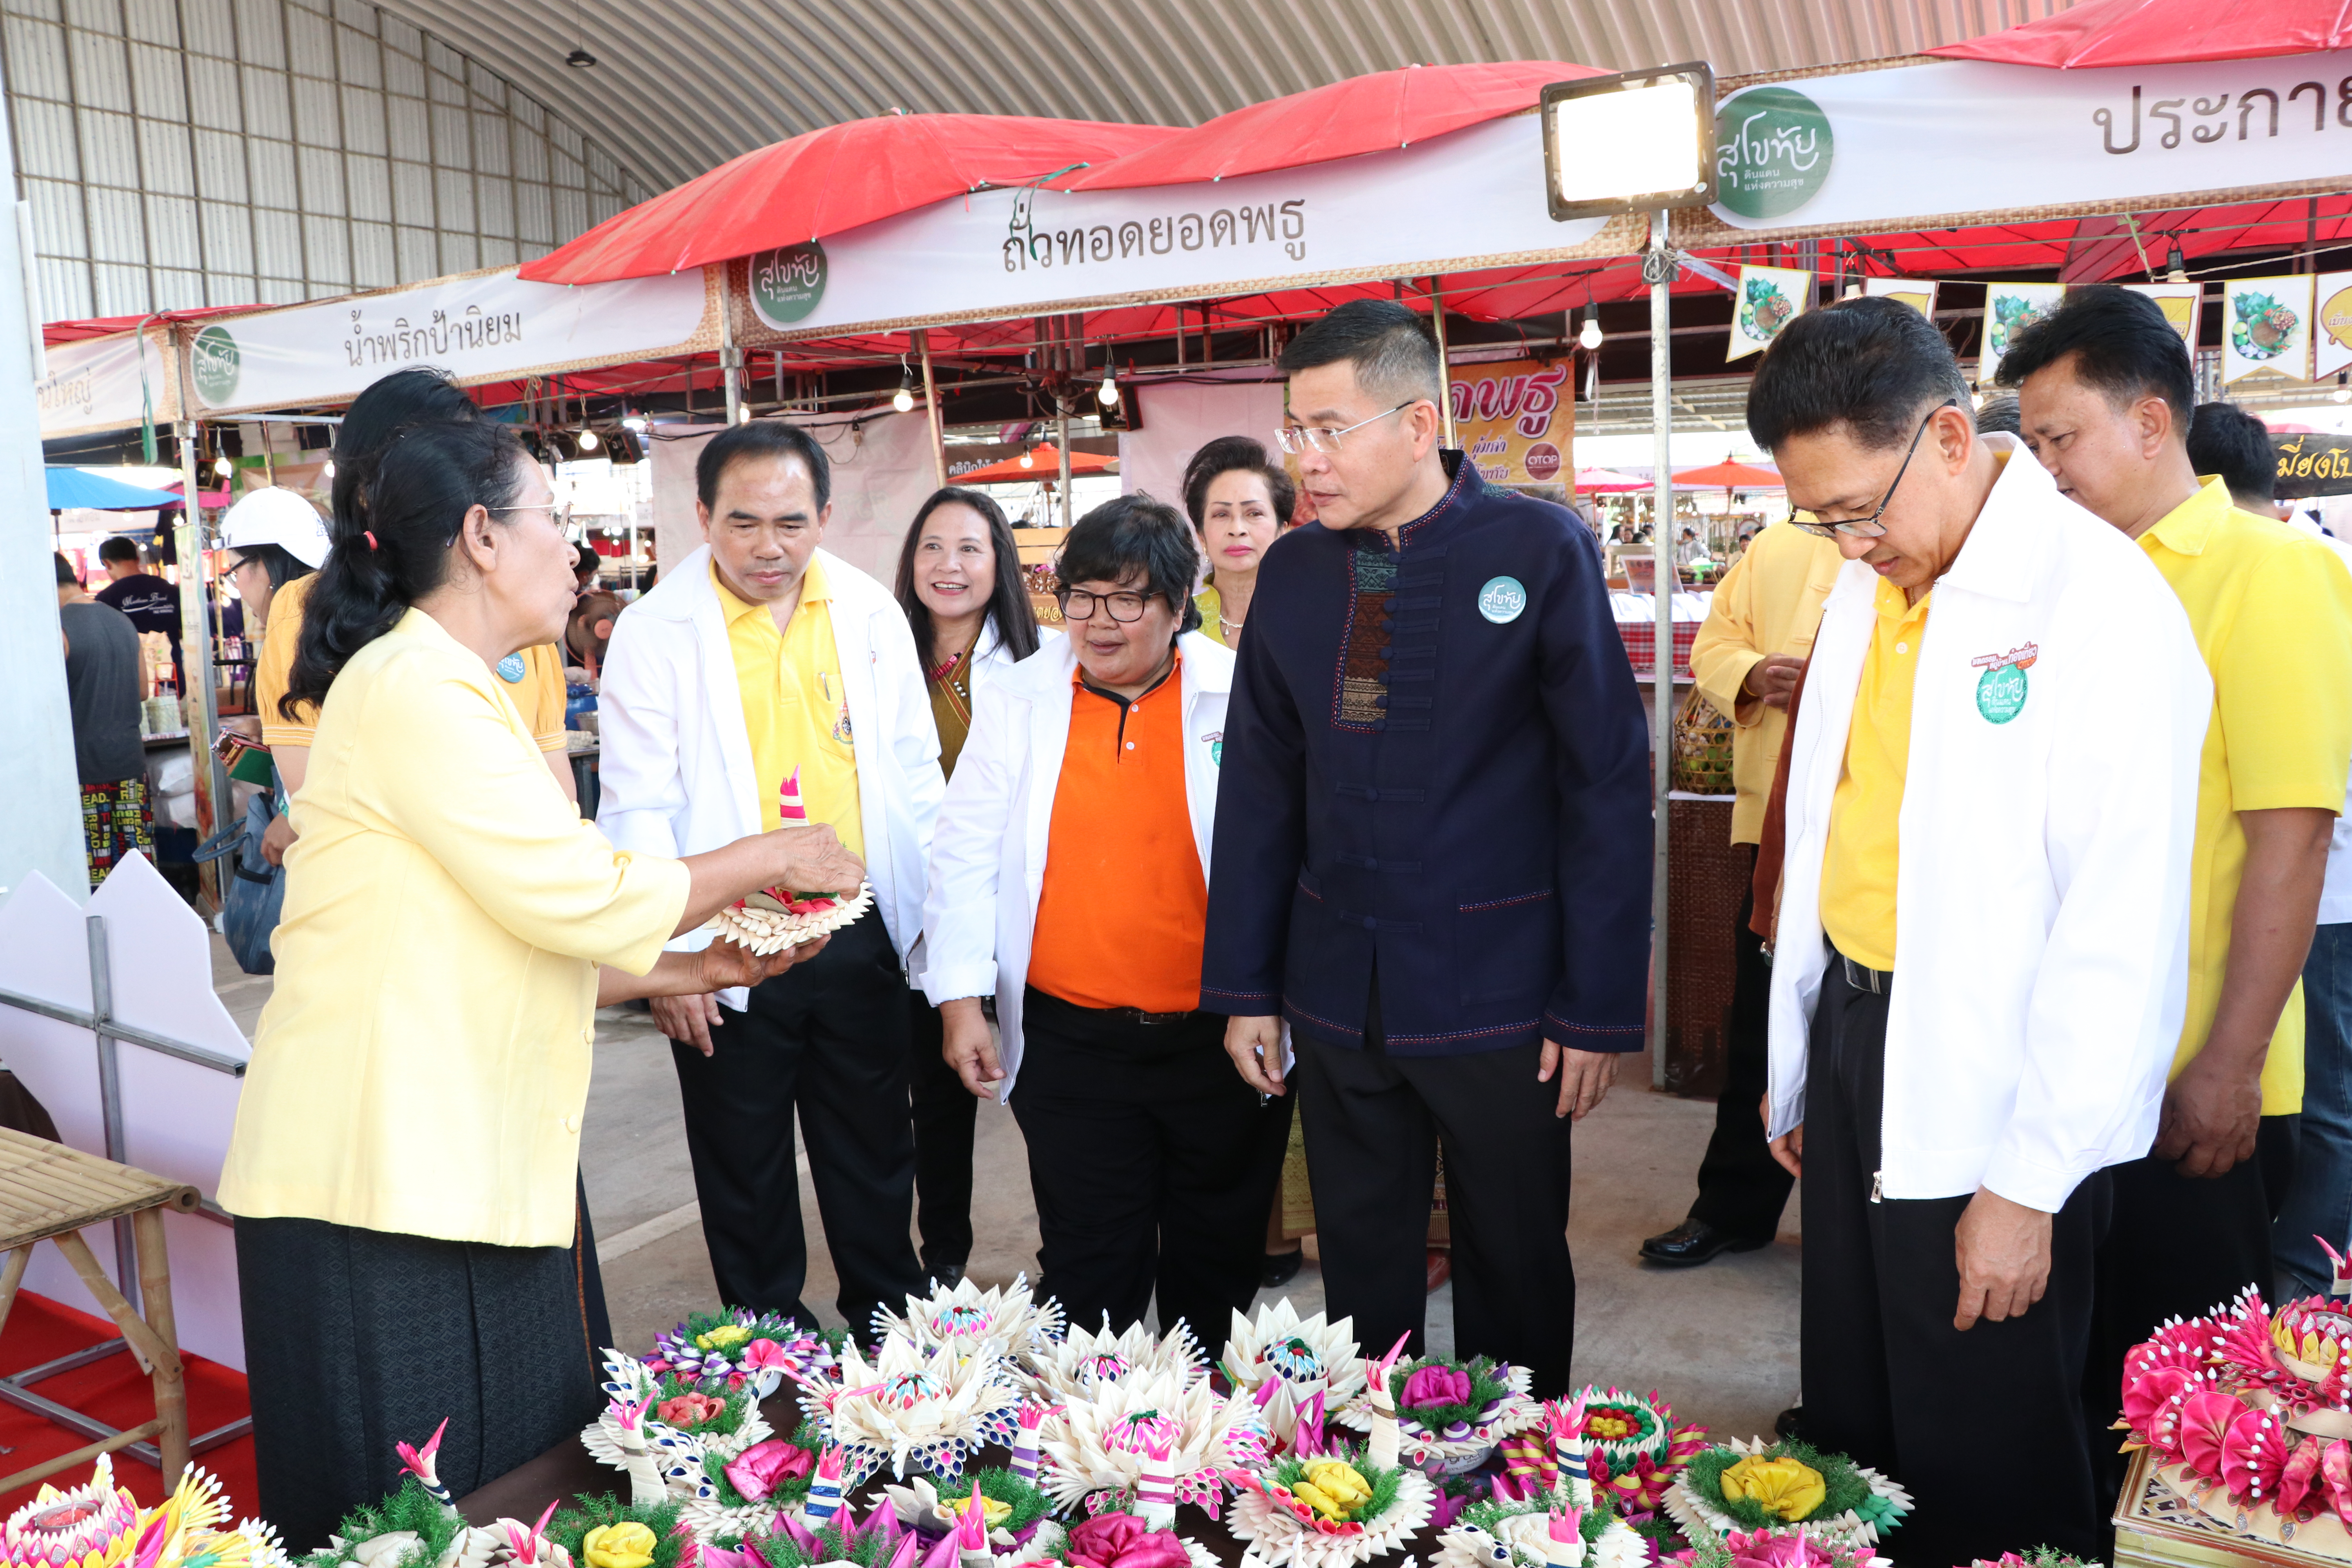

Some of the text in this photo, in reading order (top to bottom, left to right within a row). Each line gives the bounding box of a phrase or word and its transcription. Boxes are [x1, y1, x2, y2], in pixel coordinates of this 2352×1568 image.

[1717, 111, 1820, 188] สุโขทัย
[1744, 169, 1780, 180] ดินแดน
[1744, 177, 1804, 191] แห่งความสุข
[1002, 198, 1306, 273] ถั่วทอดยอดพธู
[345, 305, 521, 367] น้ำพริกป้านิยม
[38, 367, 93, 415] นใหญ่
[1437, 364, 1567, 439] ดพธู
[1475, 463, 1509, 480] โขทัย
[1528, 455, 1558, 465] OTOP
[1483, 584, 1521, 611] สุโขทัย
[1981, 668, 2025, 708] สุโขทัย
[82, 792, 110, 805] EAD.
